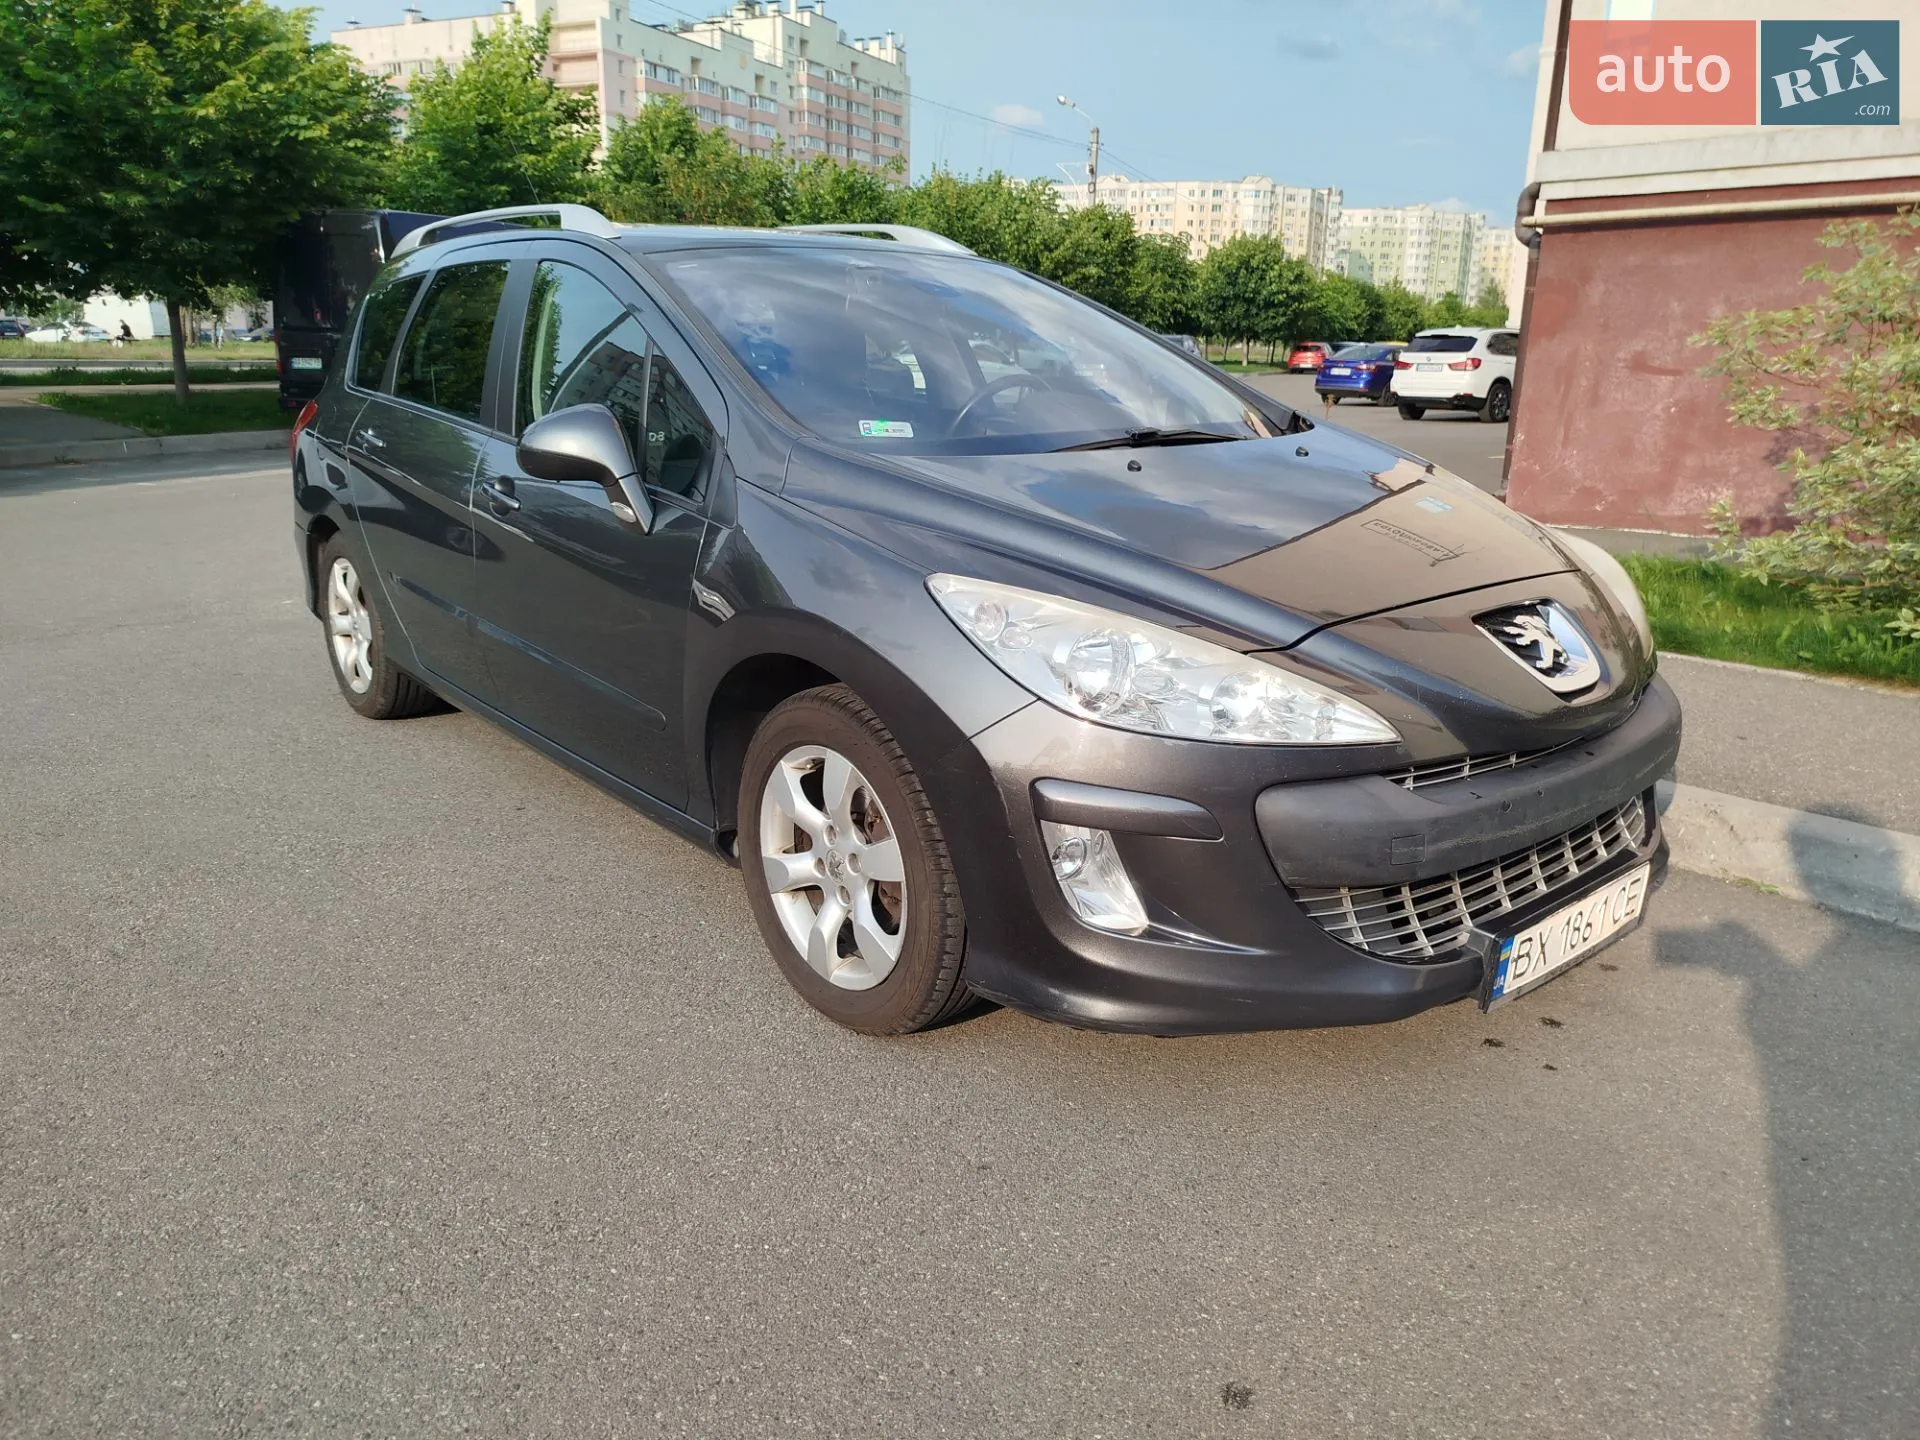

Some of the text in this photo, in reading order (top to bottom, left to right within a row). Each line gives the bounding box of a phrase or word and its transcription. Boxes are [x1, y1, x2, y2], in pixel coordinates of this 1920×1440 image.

[1510, 877, 1641, 981] BX 1861 CE
